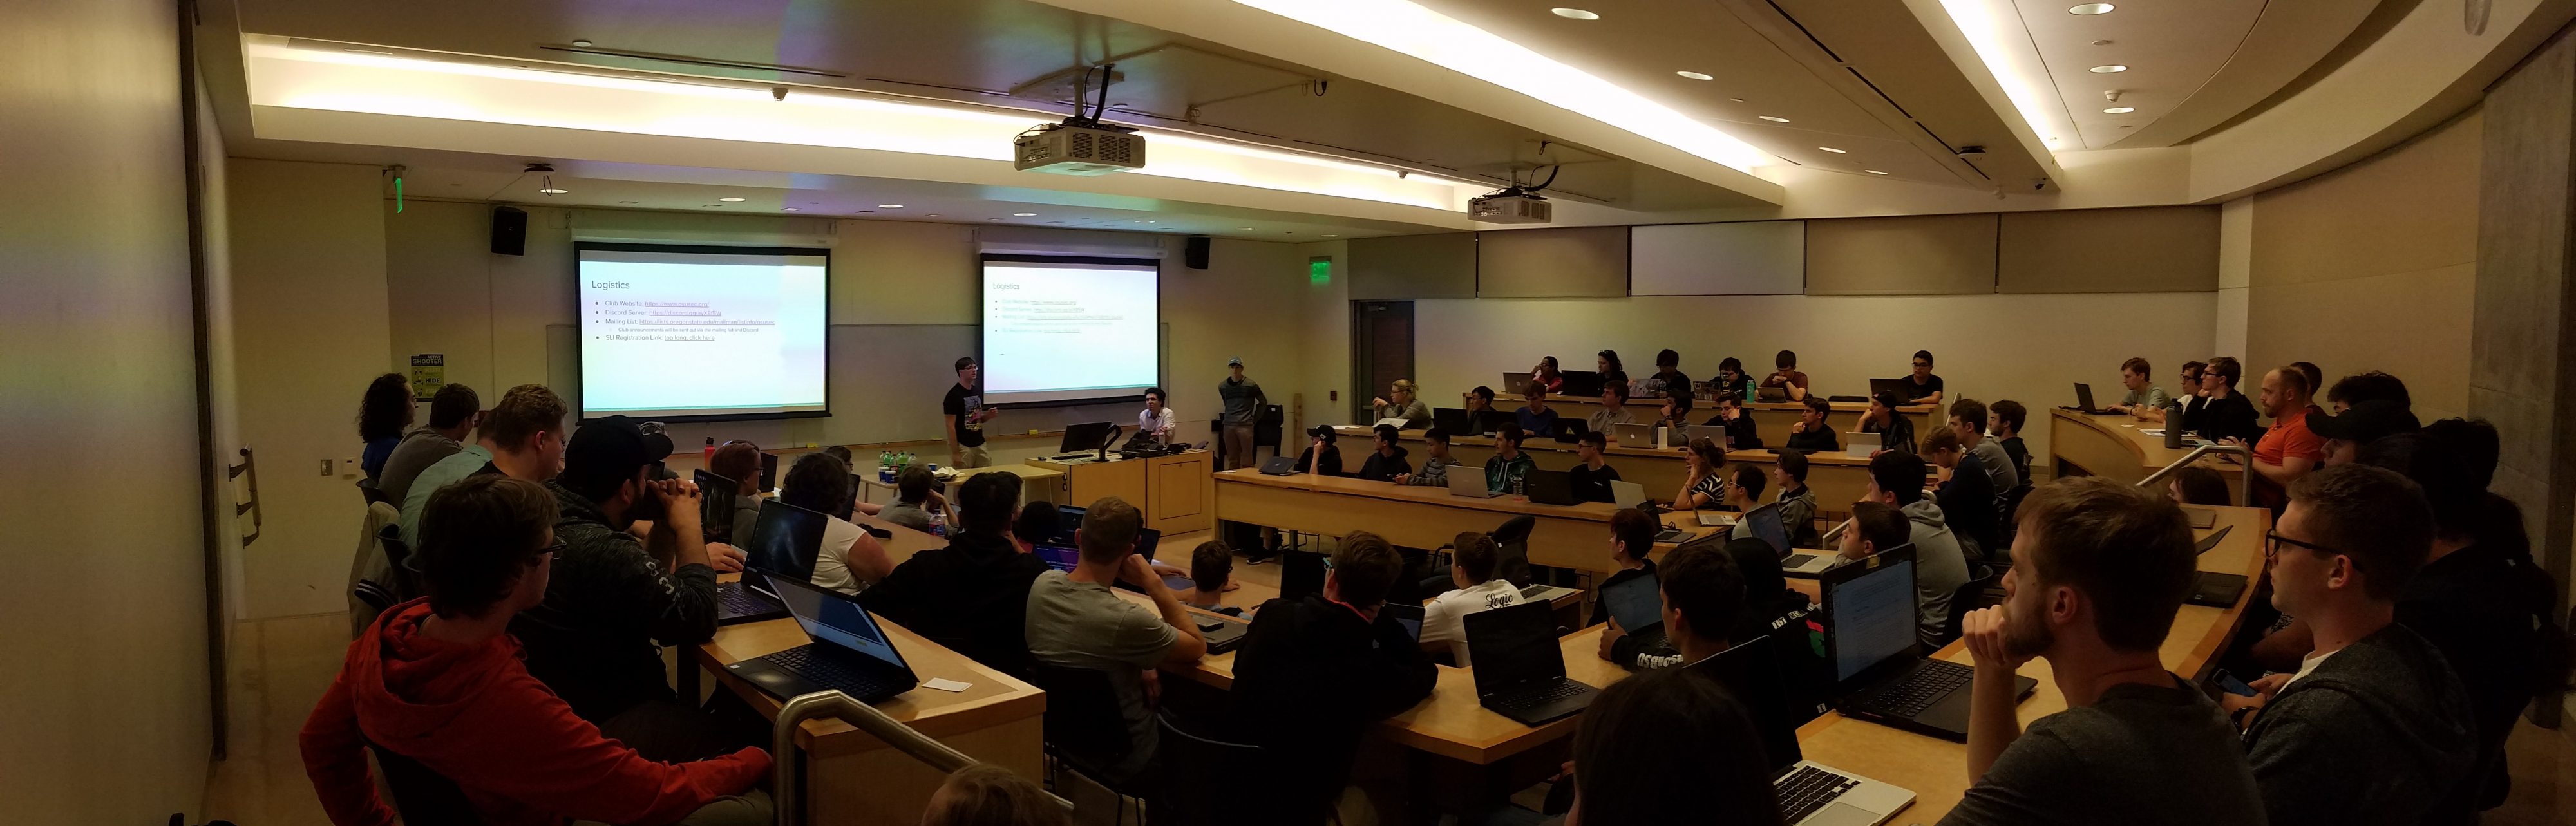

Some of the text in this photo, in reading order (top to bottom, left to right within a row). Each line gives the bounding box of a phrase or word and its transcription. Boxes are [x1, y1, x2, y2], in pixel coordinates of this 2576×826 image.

[592, 280, 630, 290] Logistics
[992, 283, 1020, 291] Logistics
[1485, 592, 1513, 609] Logic
